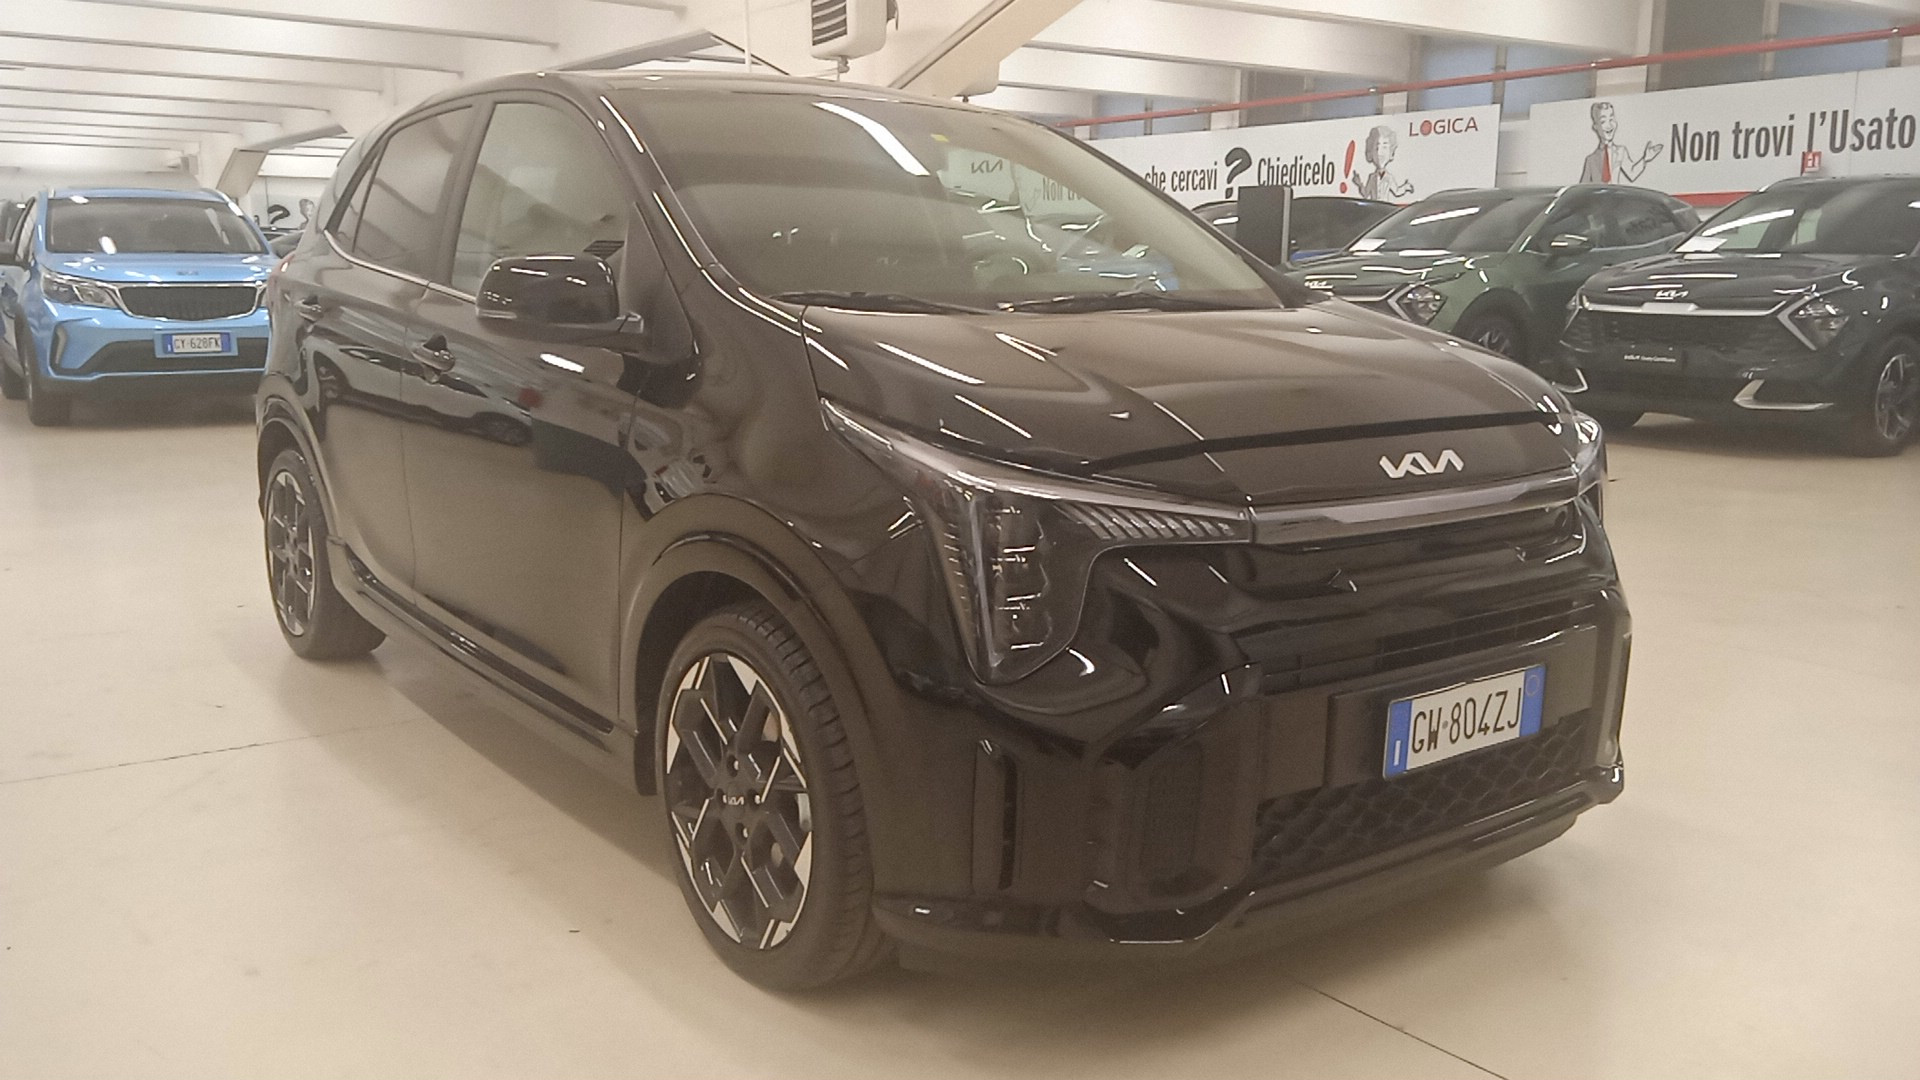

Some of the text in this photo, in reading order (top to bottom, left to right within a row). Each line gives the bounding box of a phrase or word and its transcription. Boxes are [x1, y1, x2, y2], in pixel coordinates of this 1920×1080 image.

[1409, 116, 1479, 137] LOGICA
[1670, 122, 1720, 163] Non
[1732, 113, 1795, 160] trovi
[1171, 161, 1218, 192] cercavi
[1257, 154, 1336, 187] Chiedicelo
